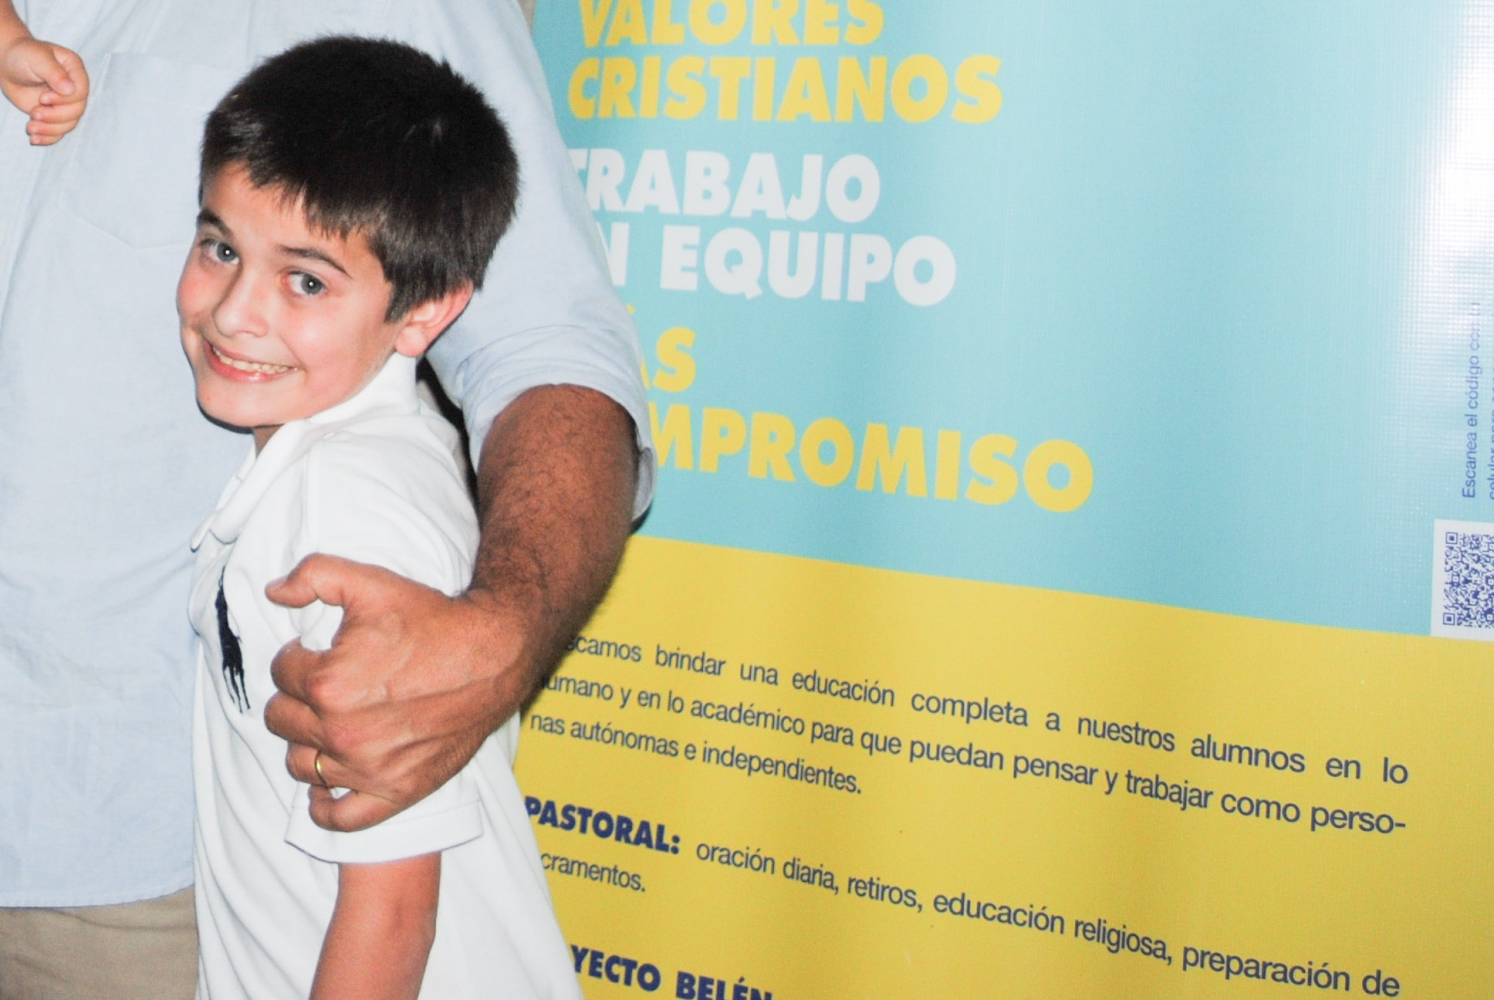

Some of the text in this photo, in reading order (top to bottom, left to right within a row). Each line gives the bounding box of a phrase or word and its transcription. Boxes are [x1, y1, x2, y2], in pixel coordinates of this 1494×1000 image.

[568, 54, 1003, 124] CRISTIANOS
[596, 221, 957, 307] N EQUIPO
[1465, 355, 1483, 410] código
[647, 401, 1094, 512] MPROMISO
[1464, 414, 1478, 427] el
[1461, 432, 1477, 499] Escanea
[568, 634, 1409, 785] camos brindar una educación completa a nuestros alumnos en lo
[530, 713, 862, 794] nas autónomas e independientes.
[620, 687, 632, 709] y
[637, 690, 662, 710] en
[667, 689, 684, 714] lo
[690, 697, 805, 736] académico
[810, 722, 854, 747] para
[859, 732, 902, 756] que
[909, 736, 1004, 771] puedan
[1013, 751, 1098, 786] pensar
[1104, 768, 1118, 795] y
[1125, 769, 1214, 811] trabajar
[1220, 789, 1301, 824] como
[1310, 802, 1407, 834] perso-
[524, 795, 1401, 998] PASTORAL: oración diaria, retiros, educación religiosa, preparación de
[541, 852, 646, 893] cramentos.
[570, 944, 661, 992] YECTO
